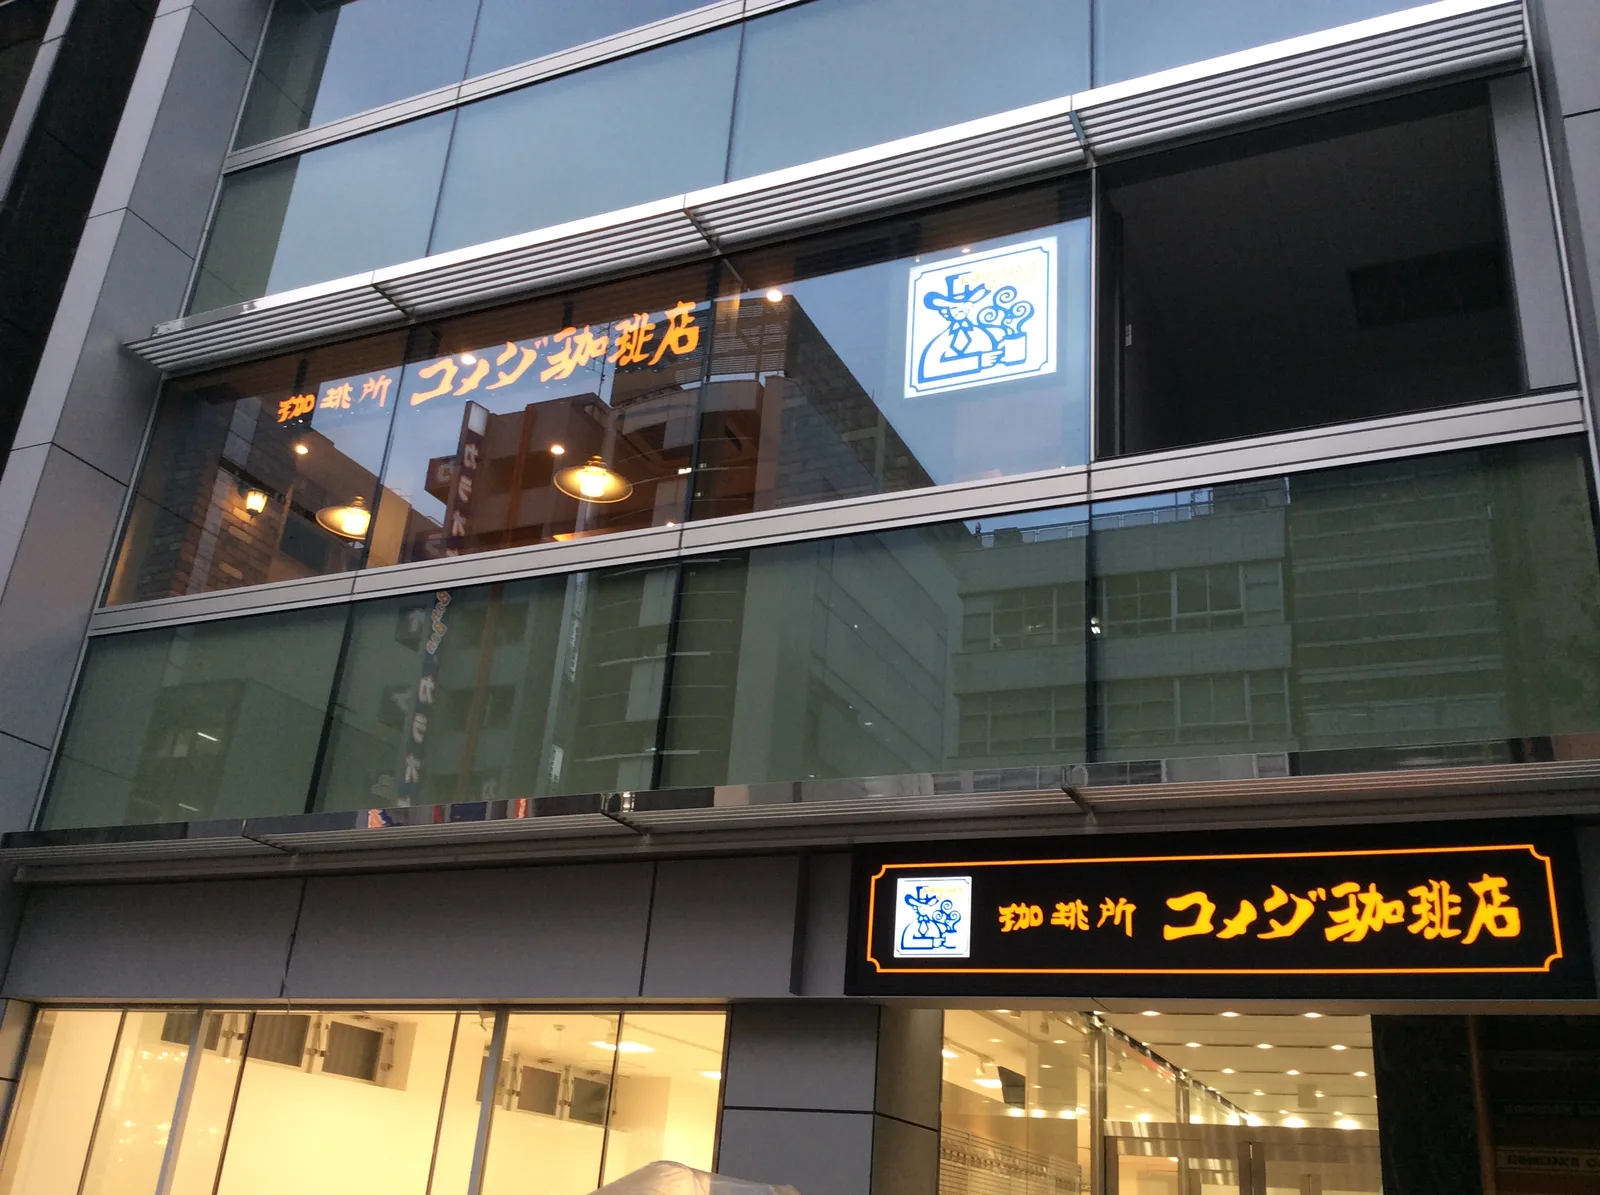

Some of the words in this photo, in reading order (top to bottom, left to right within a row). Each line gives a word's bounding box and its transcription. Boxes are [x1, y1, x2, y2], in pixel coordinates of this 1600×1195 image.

[277, 374, 392, 423] 珈琲所
[411, 300, 700, 406] コメダ珈琲店
[998, 897, 1137, 938] 珈琲所
[1163, 873, 1521, 944] コメダ珈琲店
